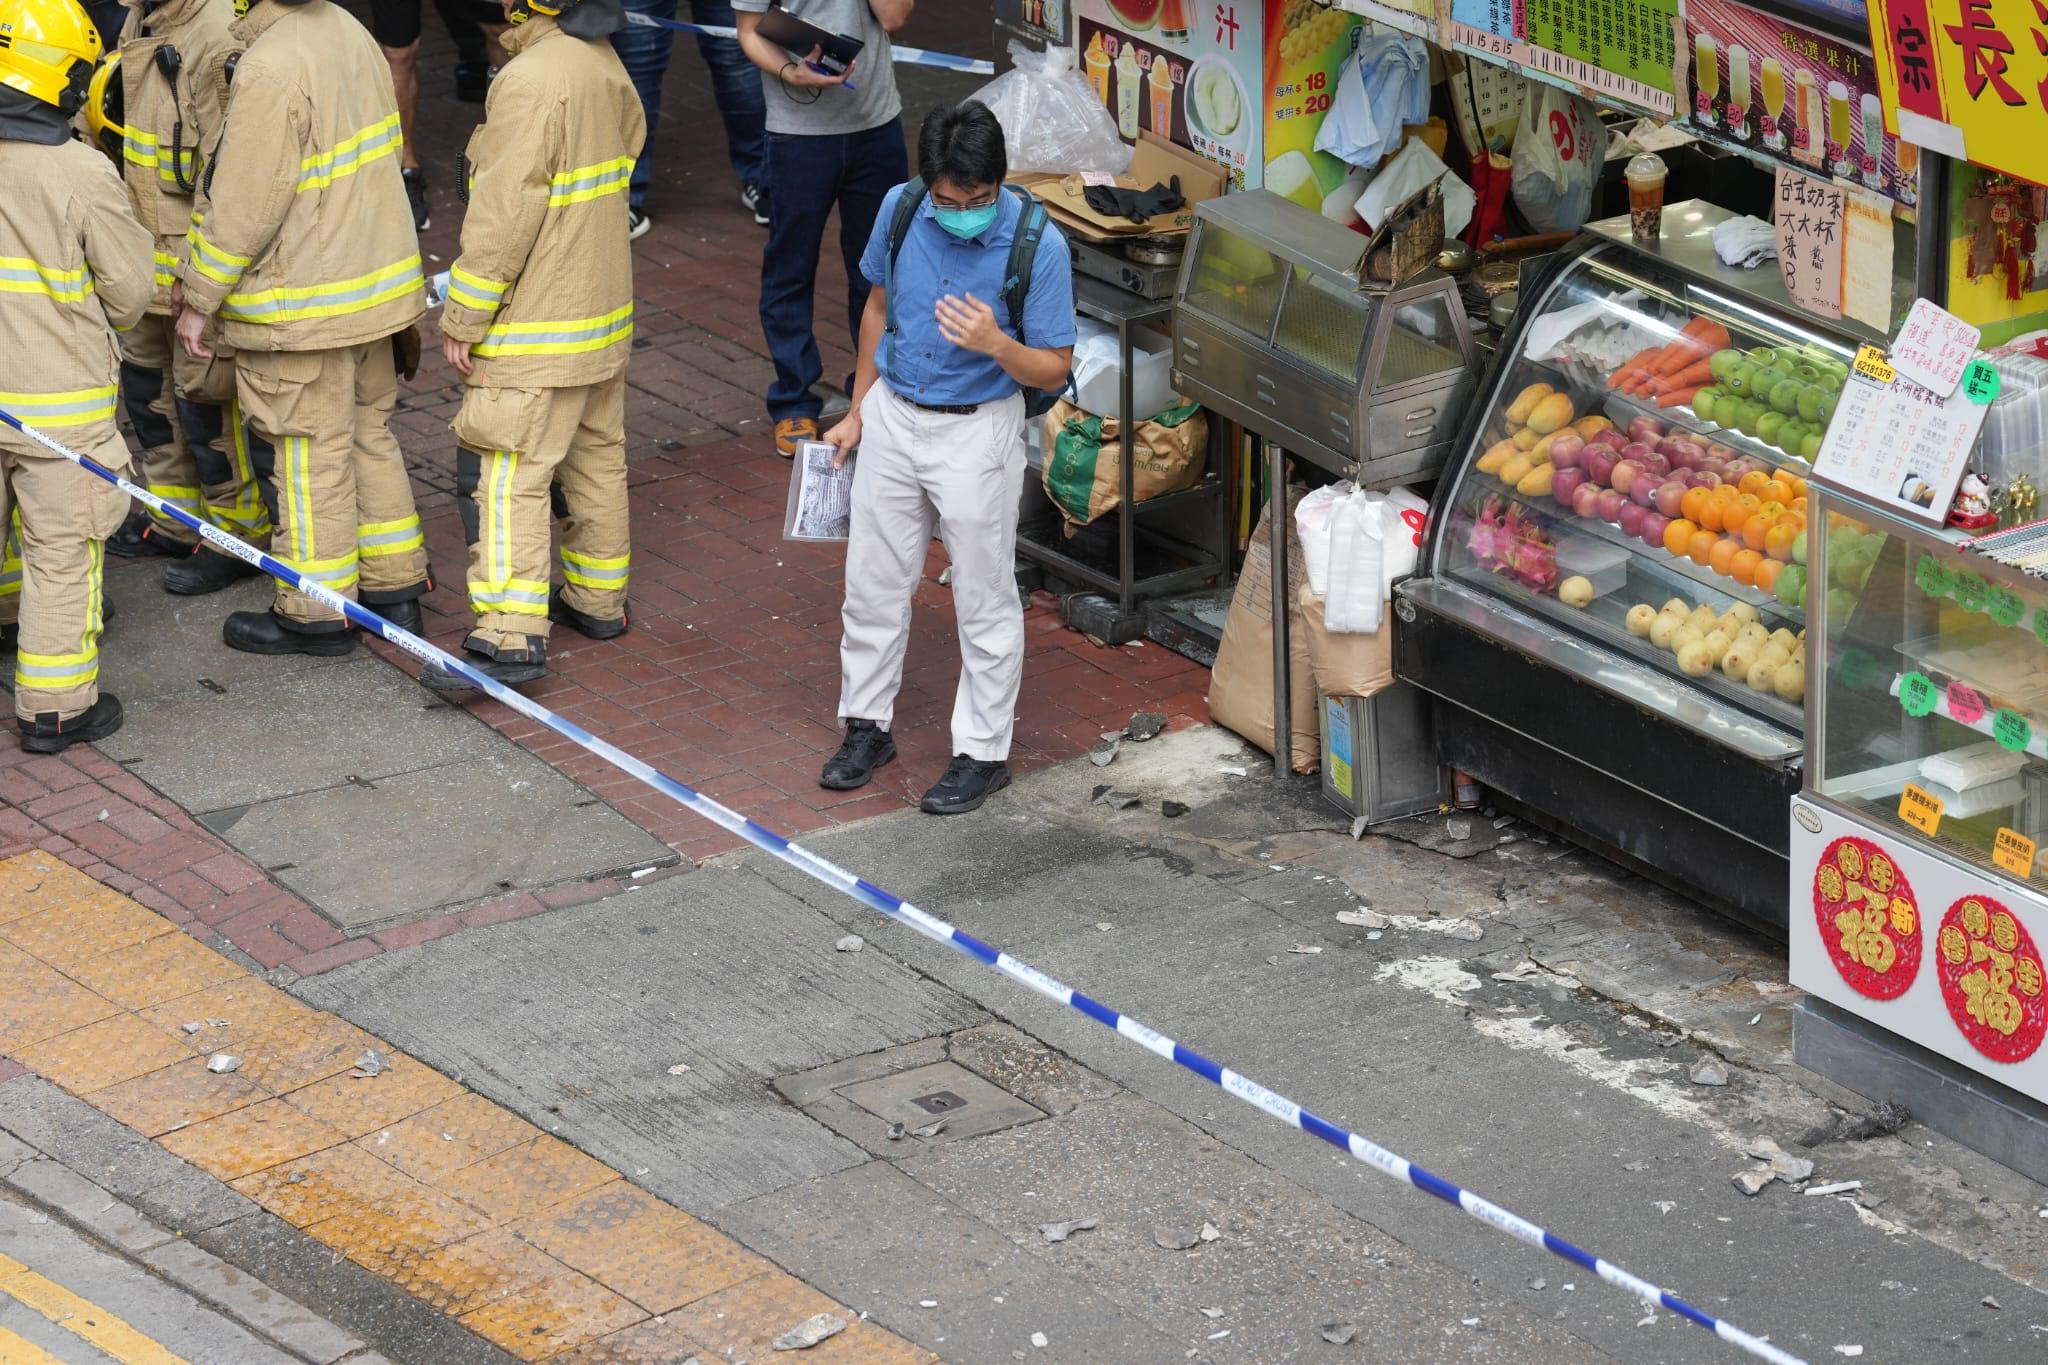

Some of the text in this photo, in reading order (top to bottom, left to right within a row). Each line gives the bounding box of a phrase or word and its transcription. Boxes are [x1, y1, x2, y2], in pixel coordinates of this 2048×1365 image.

[1215, 4, 1240, 50] 汁
[1782, 31, 1861, 77] 特選果汁
[1897, 15, 1931, 94] 宗
[1698, 94, 1709, 113] 20
[1729, 107, 1740, 123] 20
[1761, 118, 1774, 133] 20
[1795, 130, 1807, 144] 20
[1829, 143, 1841, 157] 20
[1863, 156, 1875, 170] 20
[1780, 172, 1842, 219] 台式奶茶
[1785, 261, 1796, 290] 8
[1972, 364, 1993, 384] 買五
[1967, 379, 1988, 396] 送一
[202, 527, 226, 545] POLICE
